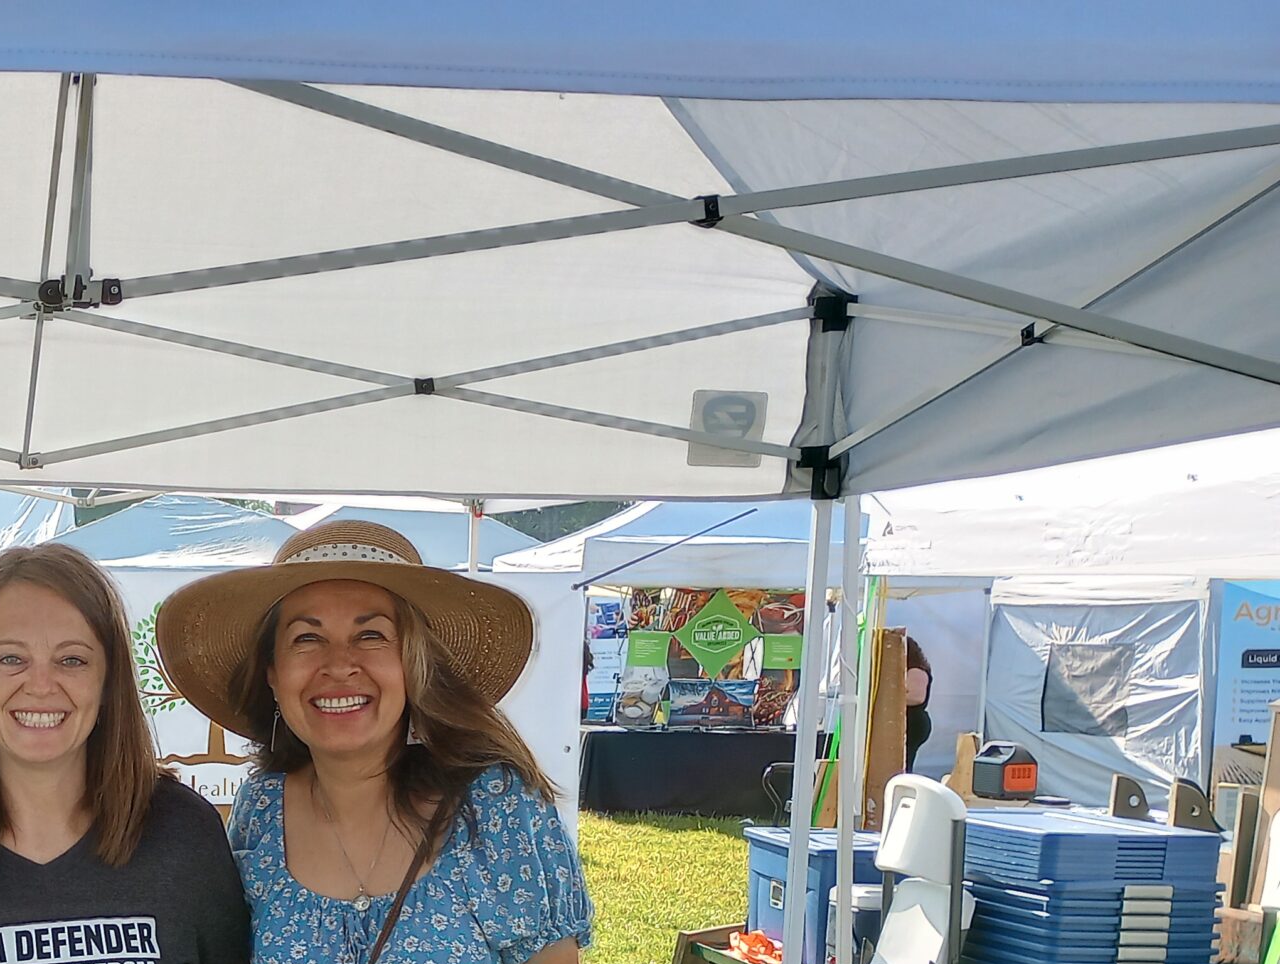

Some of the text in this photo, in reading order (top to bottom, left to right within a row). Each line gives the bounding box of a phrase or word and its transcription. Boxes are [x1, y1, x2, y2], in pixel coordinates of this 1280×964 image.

[695, 631, 740, 640] VALUE ADDED
[1248, 654, 1278, 665] Liquid
[15, 922, 156, 962] DEFENDER
